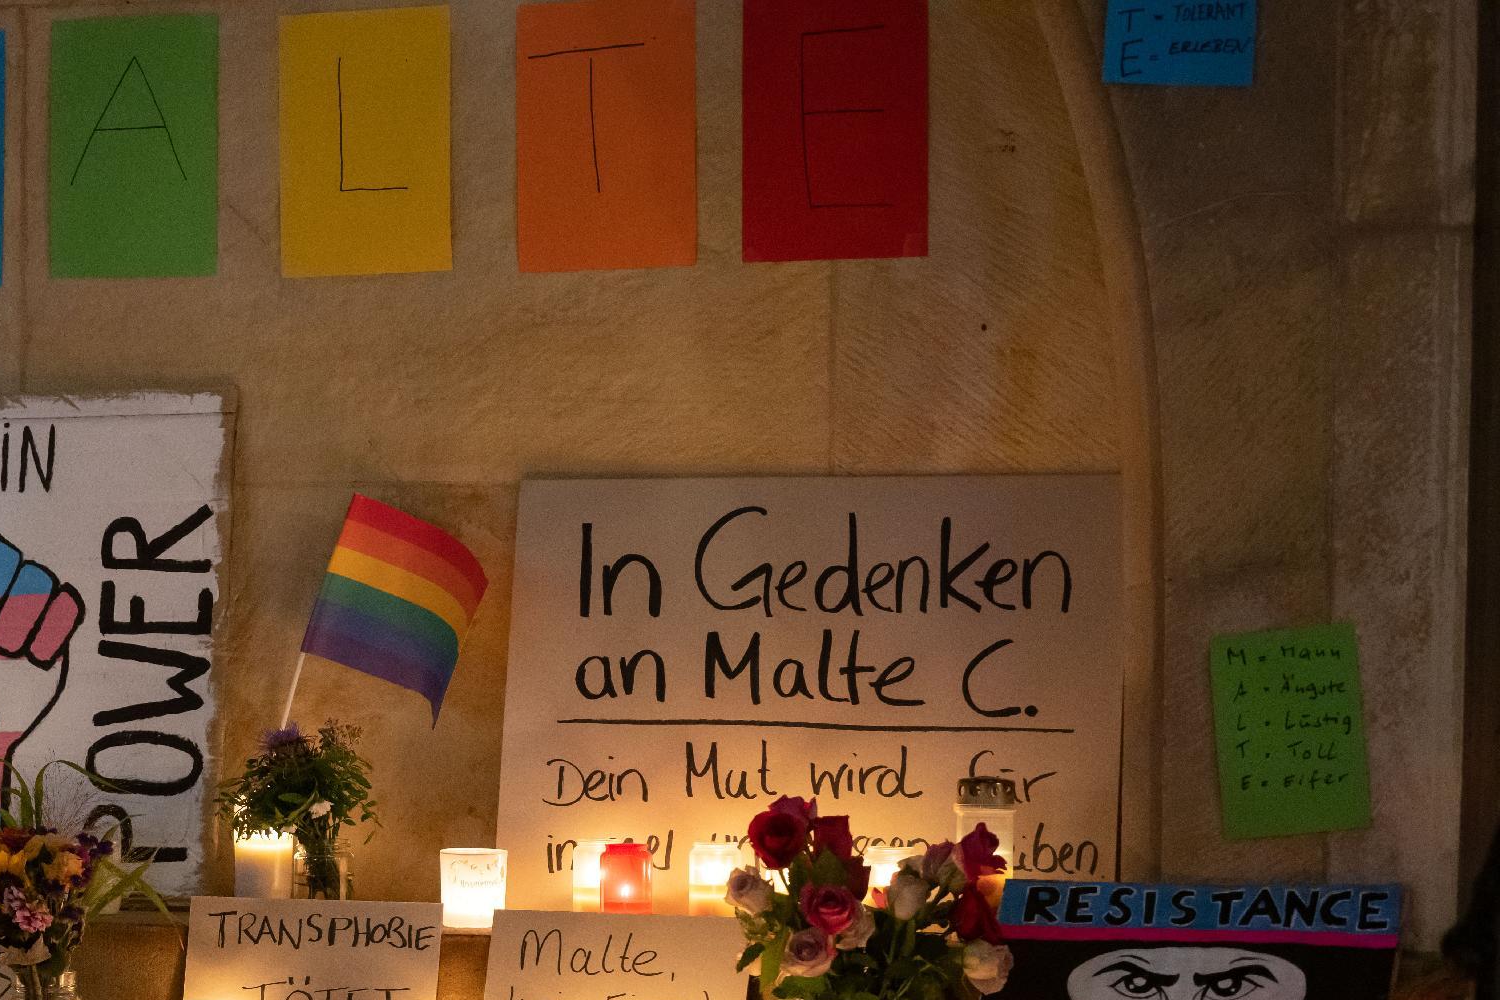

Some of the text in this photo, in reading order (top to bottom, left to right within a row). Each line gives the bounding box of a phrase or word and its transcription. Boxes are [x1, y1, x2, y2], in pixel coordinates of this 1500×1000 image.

[1120, 38, 1144, 78] E
[579, 506, 1073, 619] In Gedenken
[83, 503, 215, 864] POWER
[575, 629, 1040, 719] an Malte C.
[542, 755, 649, 807] Dein
[686, 738, 778, 800] Mut
[810, 744, 923, 800] wird
[208, 910, 437, 951] TRANSPHOBIE
[1021, 885, 1389, 930] RESISTANCE
[520, 928, 676, 982] Malte,
